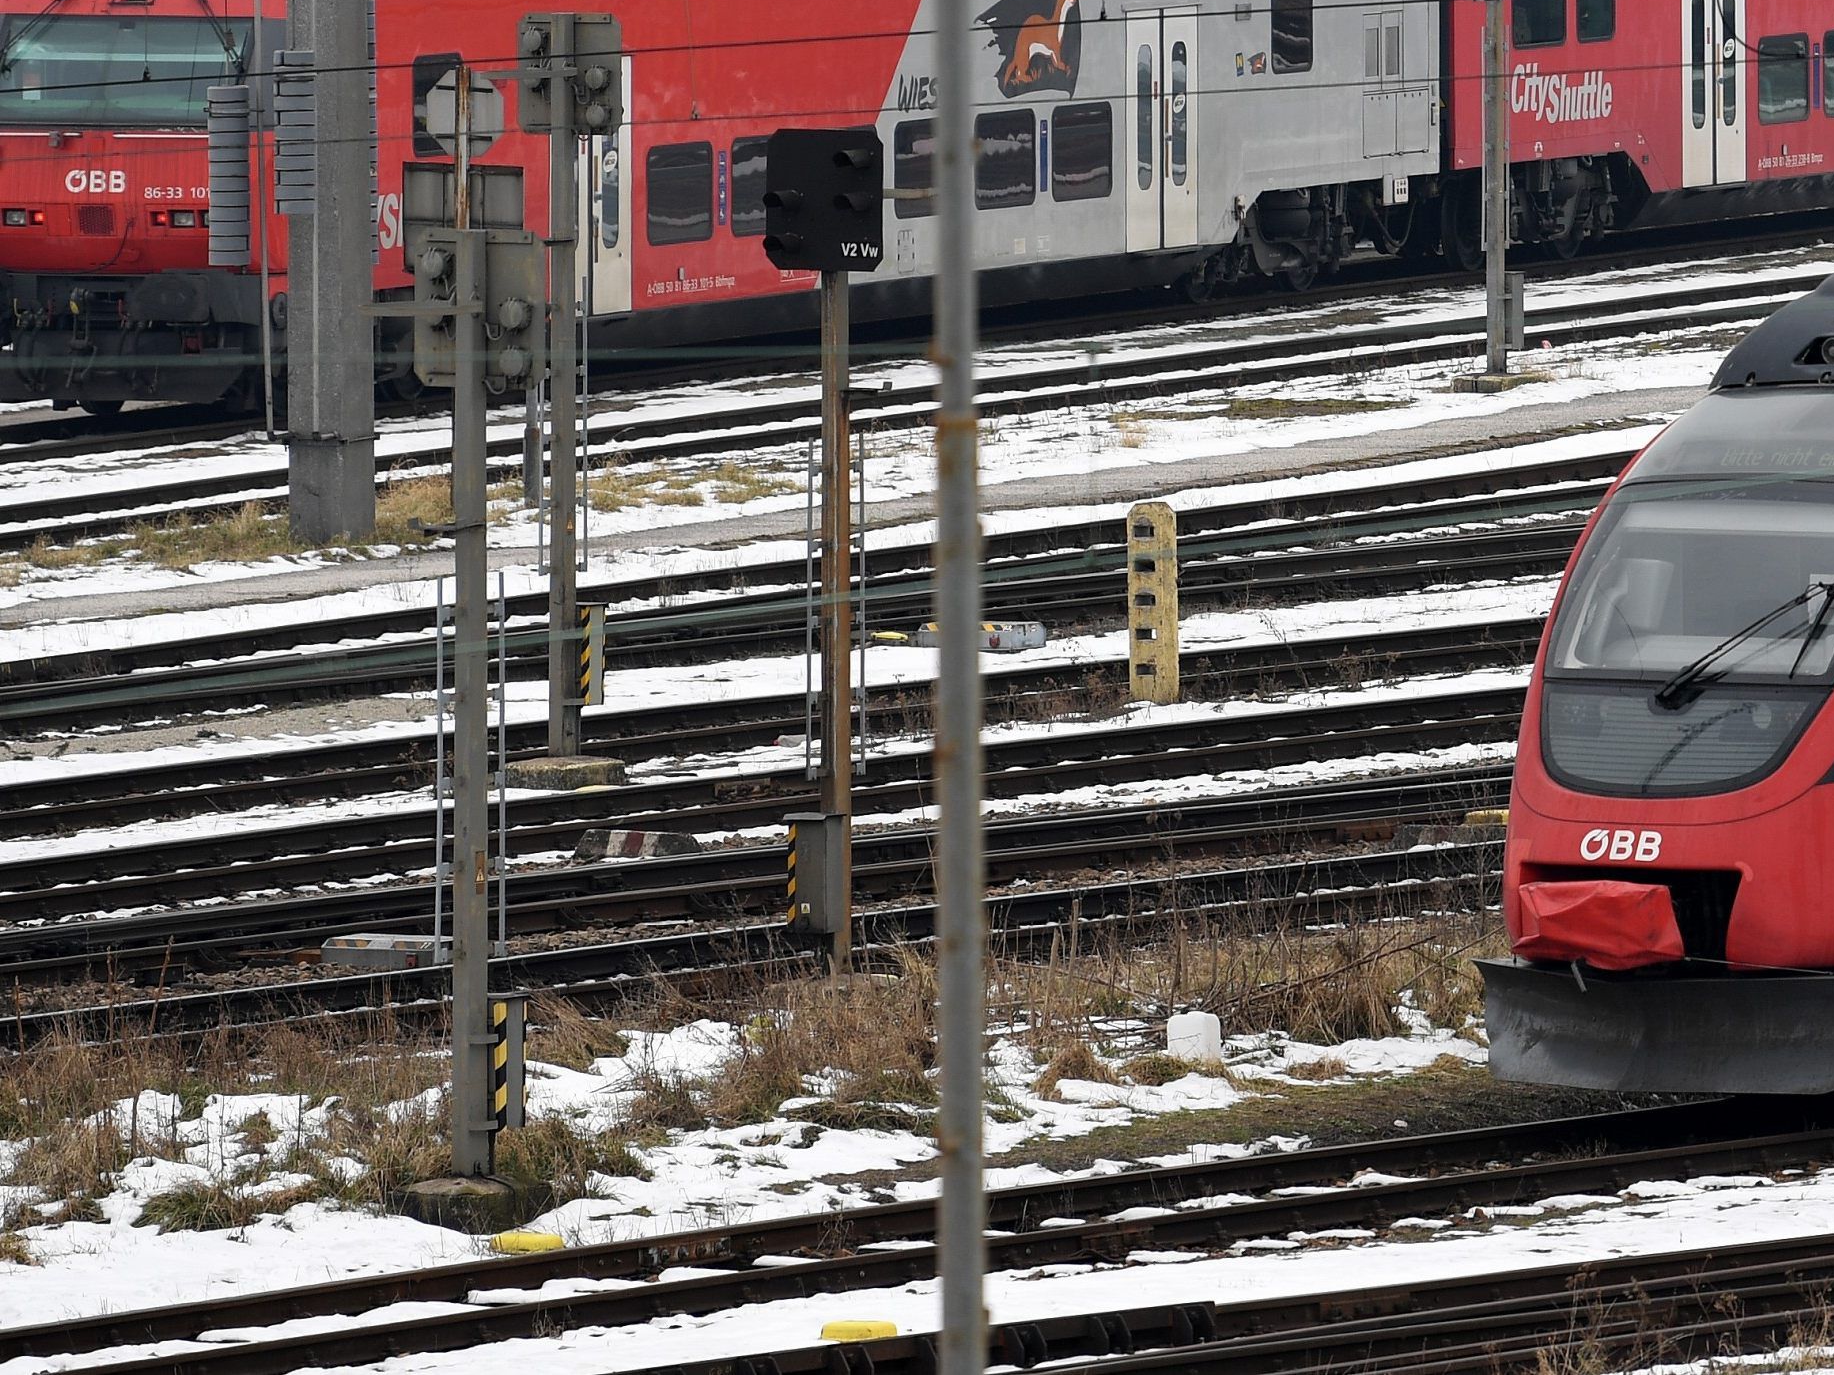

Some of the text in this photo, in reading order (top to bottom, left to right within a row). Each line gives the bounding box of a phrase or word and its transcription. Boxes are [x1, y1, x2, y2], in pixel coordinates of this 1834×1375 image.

[1511, 63, 1612, 124] CityShuttle
[64, 169, 127, 194] ÖBB
[143, 186, 184, 200] 86-33
[841, 242, 879, 258] V2 Vw
[1580, 828, 1663, 862] ÖBB
